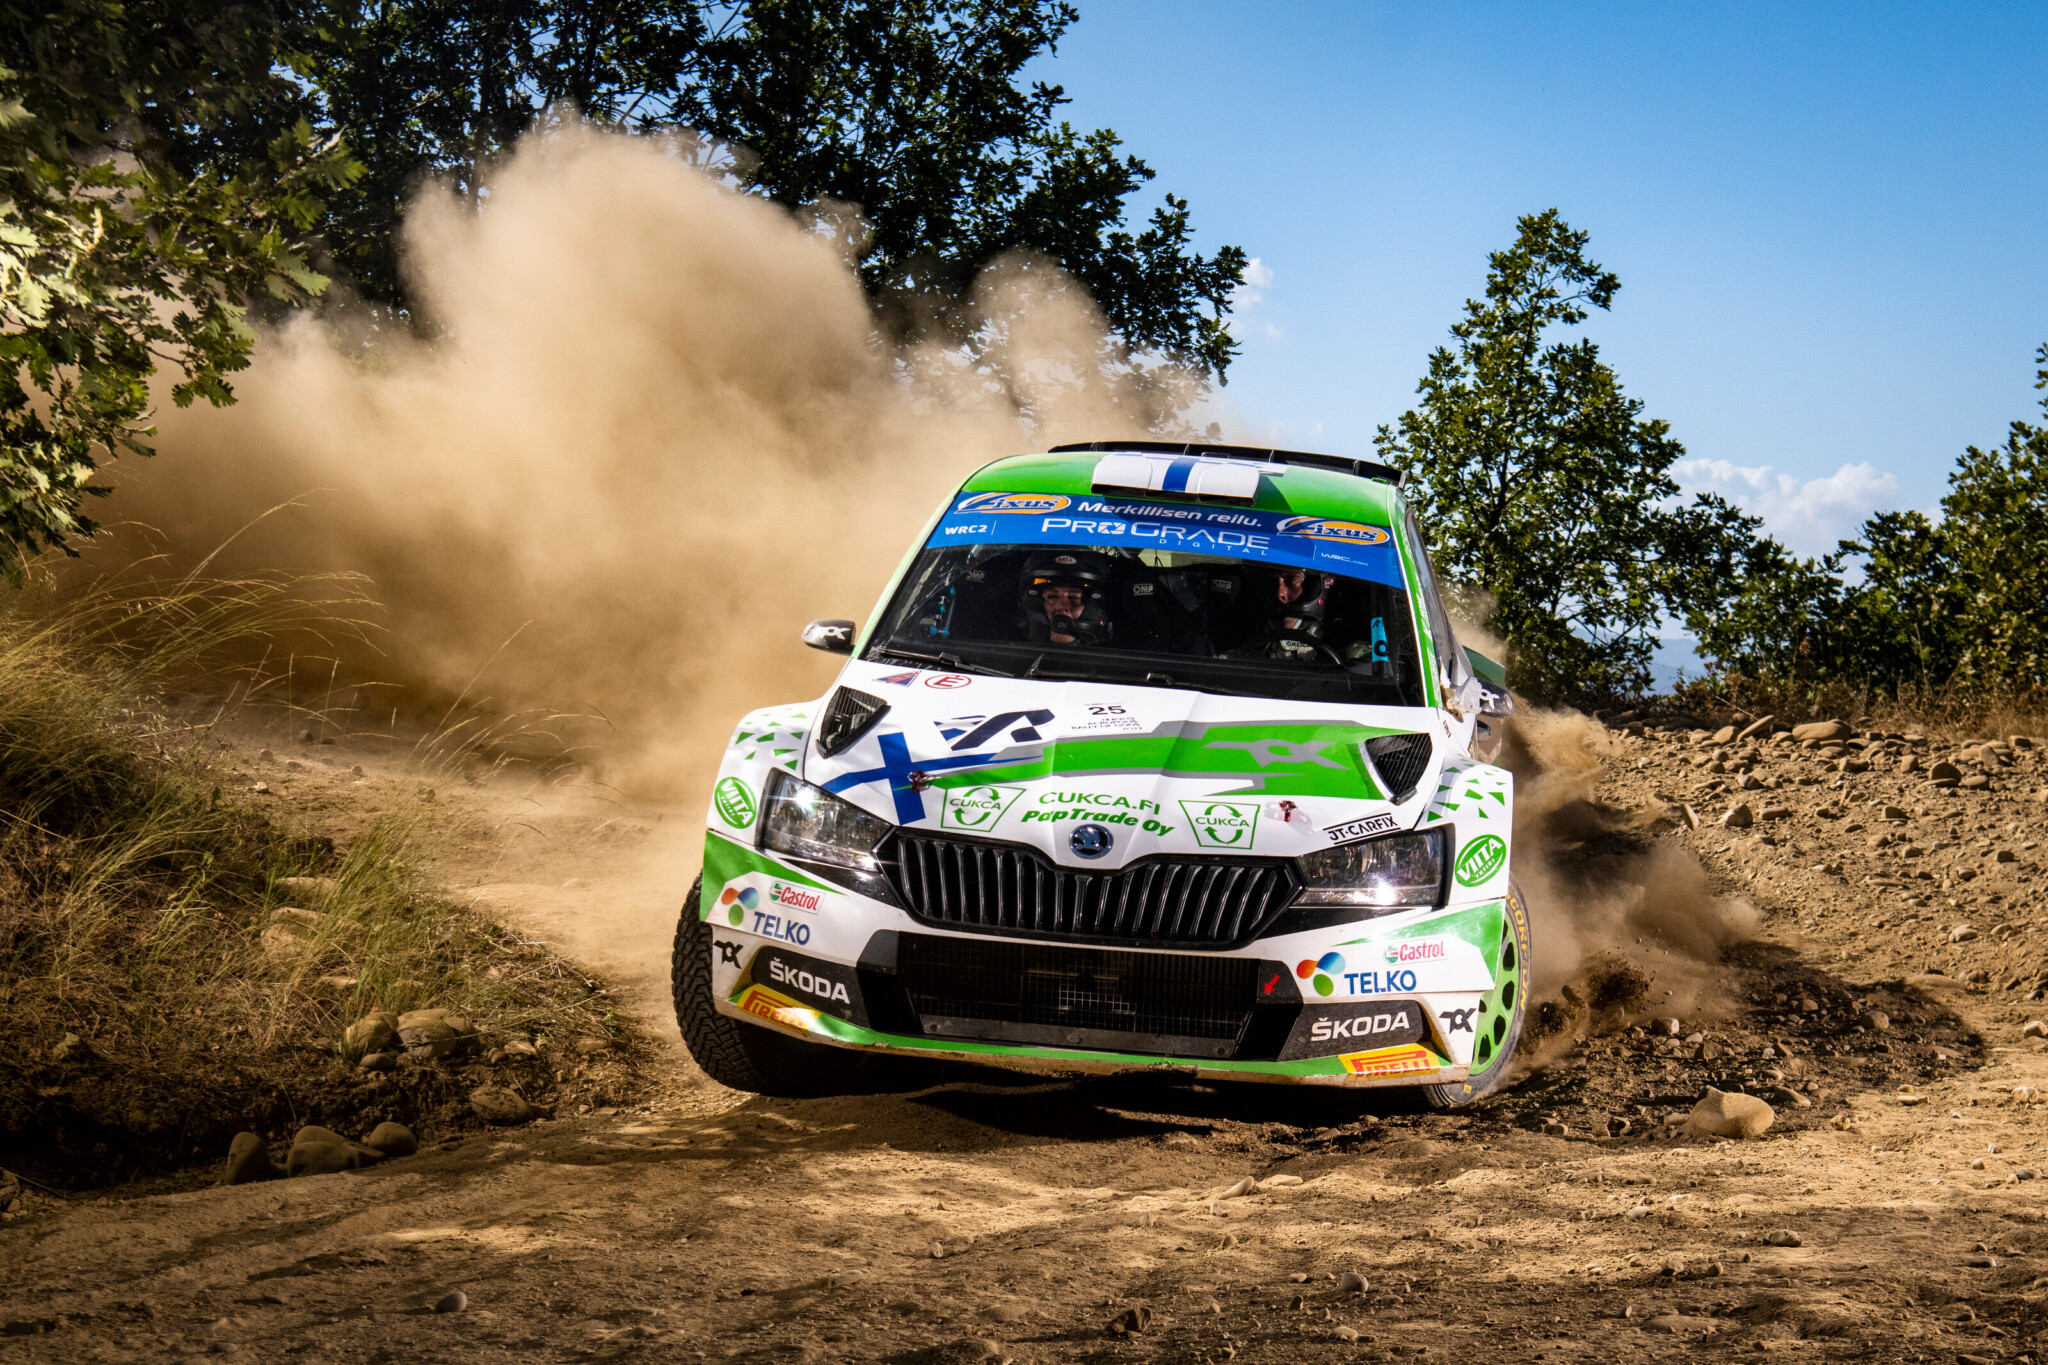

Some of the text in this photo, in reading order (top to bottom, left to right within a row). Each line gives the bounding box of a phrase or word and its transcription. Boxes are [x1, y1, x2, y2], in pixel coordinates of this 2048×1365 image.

[1077, 501, 1262, 527] Merkillisen reilu.
[945, 525, 988, 535] WRC2
[1159, 539, 1267, 556] DIGITAL
[1133, 585, 1154, 594] OMP
[1088, 706, 1126, 715] 25
[949, 798, 1001, 810] CUKCA
[1039, 792, 1161, 816] CUKCA.FI
[1142, 819, 1175, 837] Oy
[1195, 816, 1250, 828] CUKCA
[779, 887, 820, 911] Castrol
[753, 911, 811, 946] TELKO
[1400, 940, 1445, 961] Castrol
[769, 956, 850, 1005] ŠKODA
[1344, 969, 1417, 995] TELKO
[1310, 1011, 1411, 1042] ŠKODA
[1350, 1050, 1431, 1077] PIRELLI
